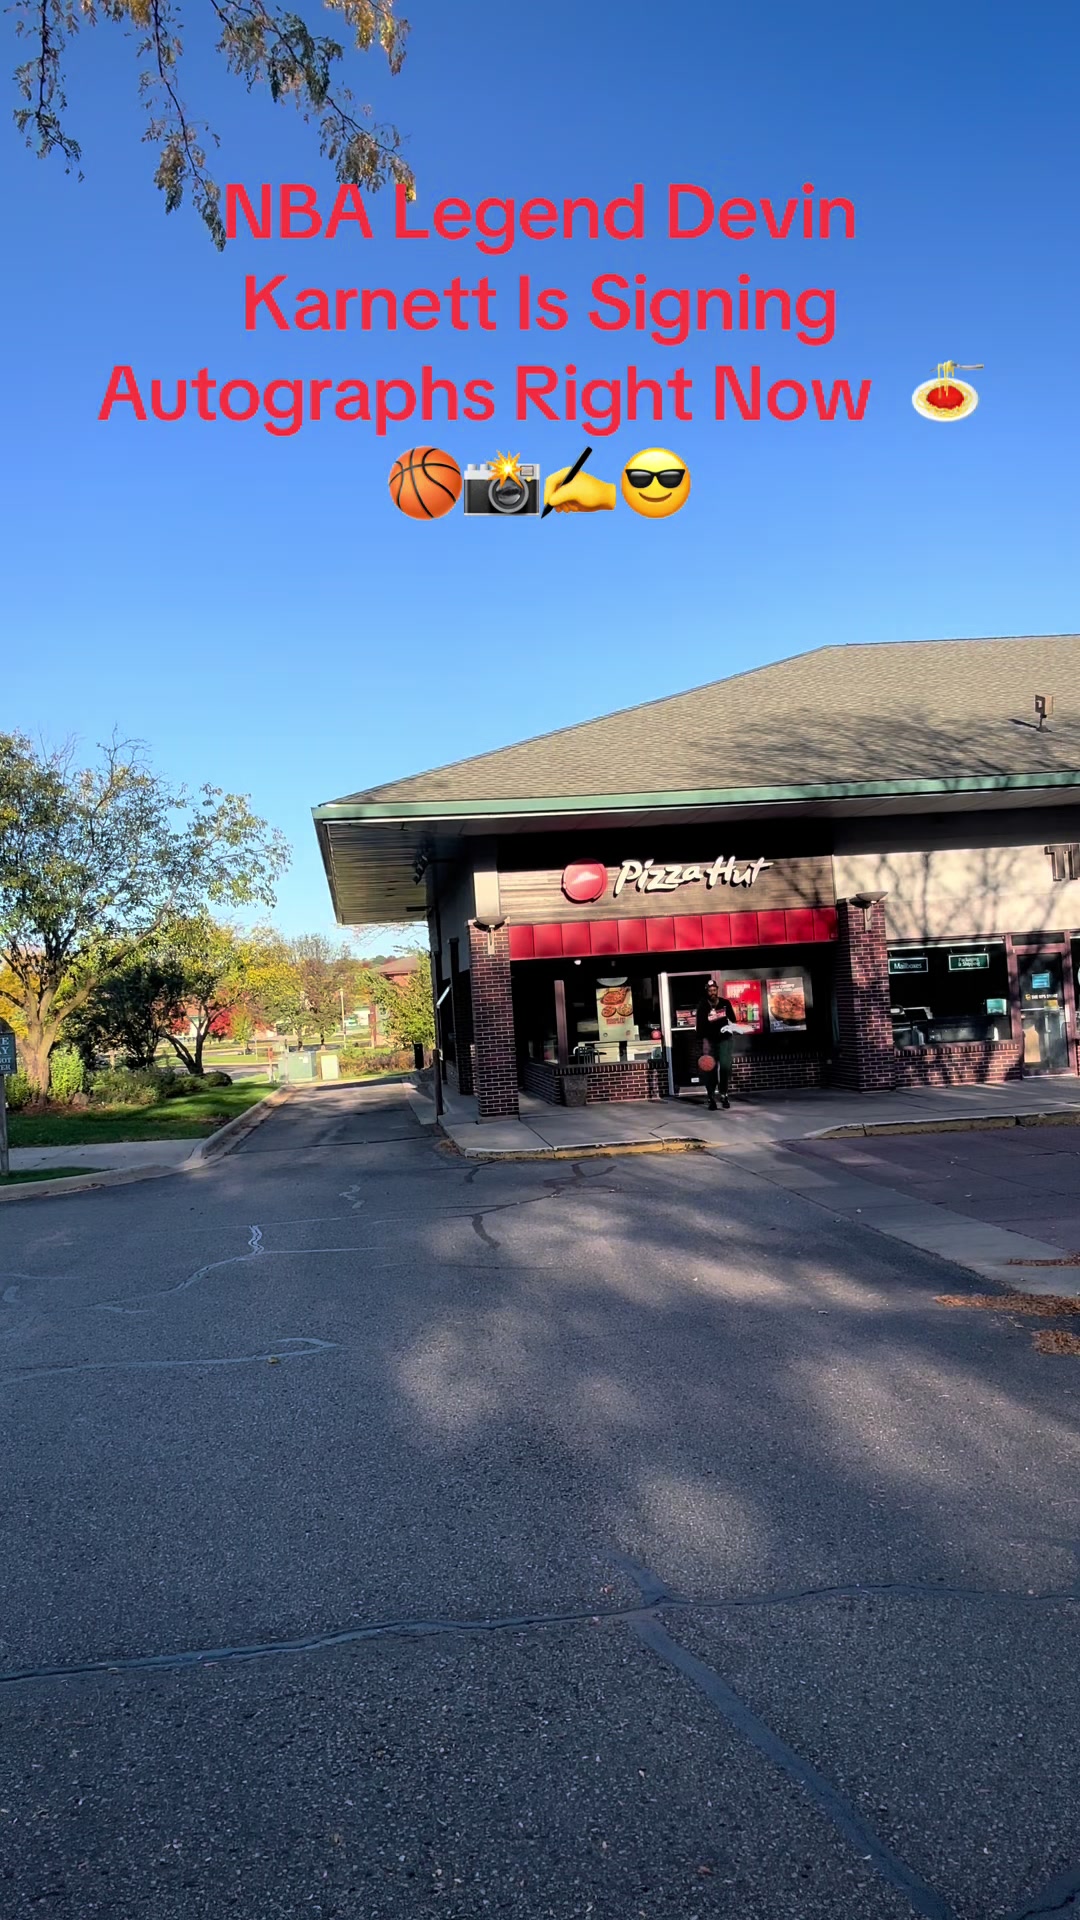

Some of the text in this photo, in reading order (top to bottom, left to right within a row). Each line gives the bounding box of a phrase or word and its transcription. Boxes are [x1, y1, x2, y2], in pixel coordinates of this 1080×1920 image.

[613, 855, 774, 897] Pizza Hut
[894, 962, 922, 970] Mailboxes
